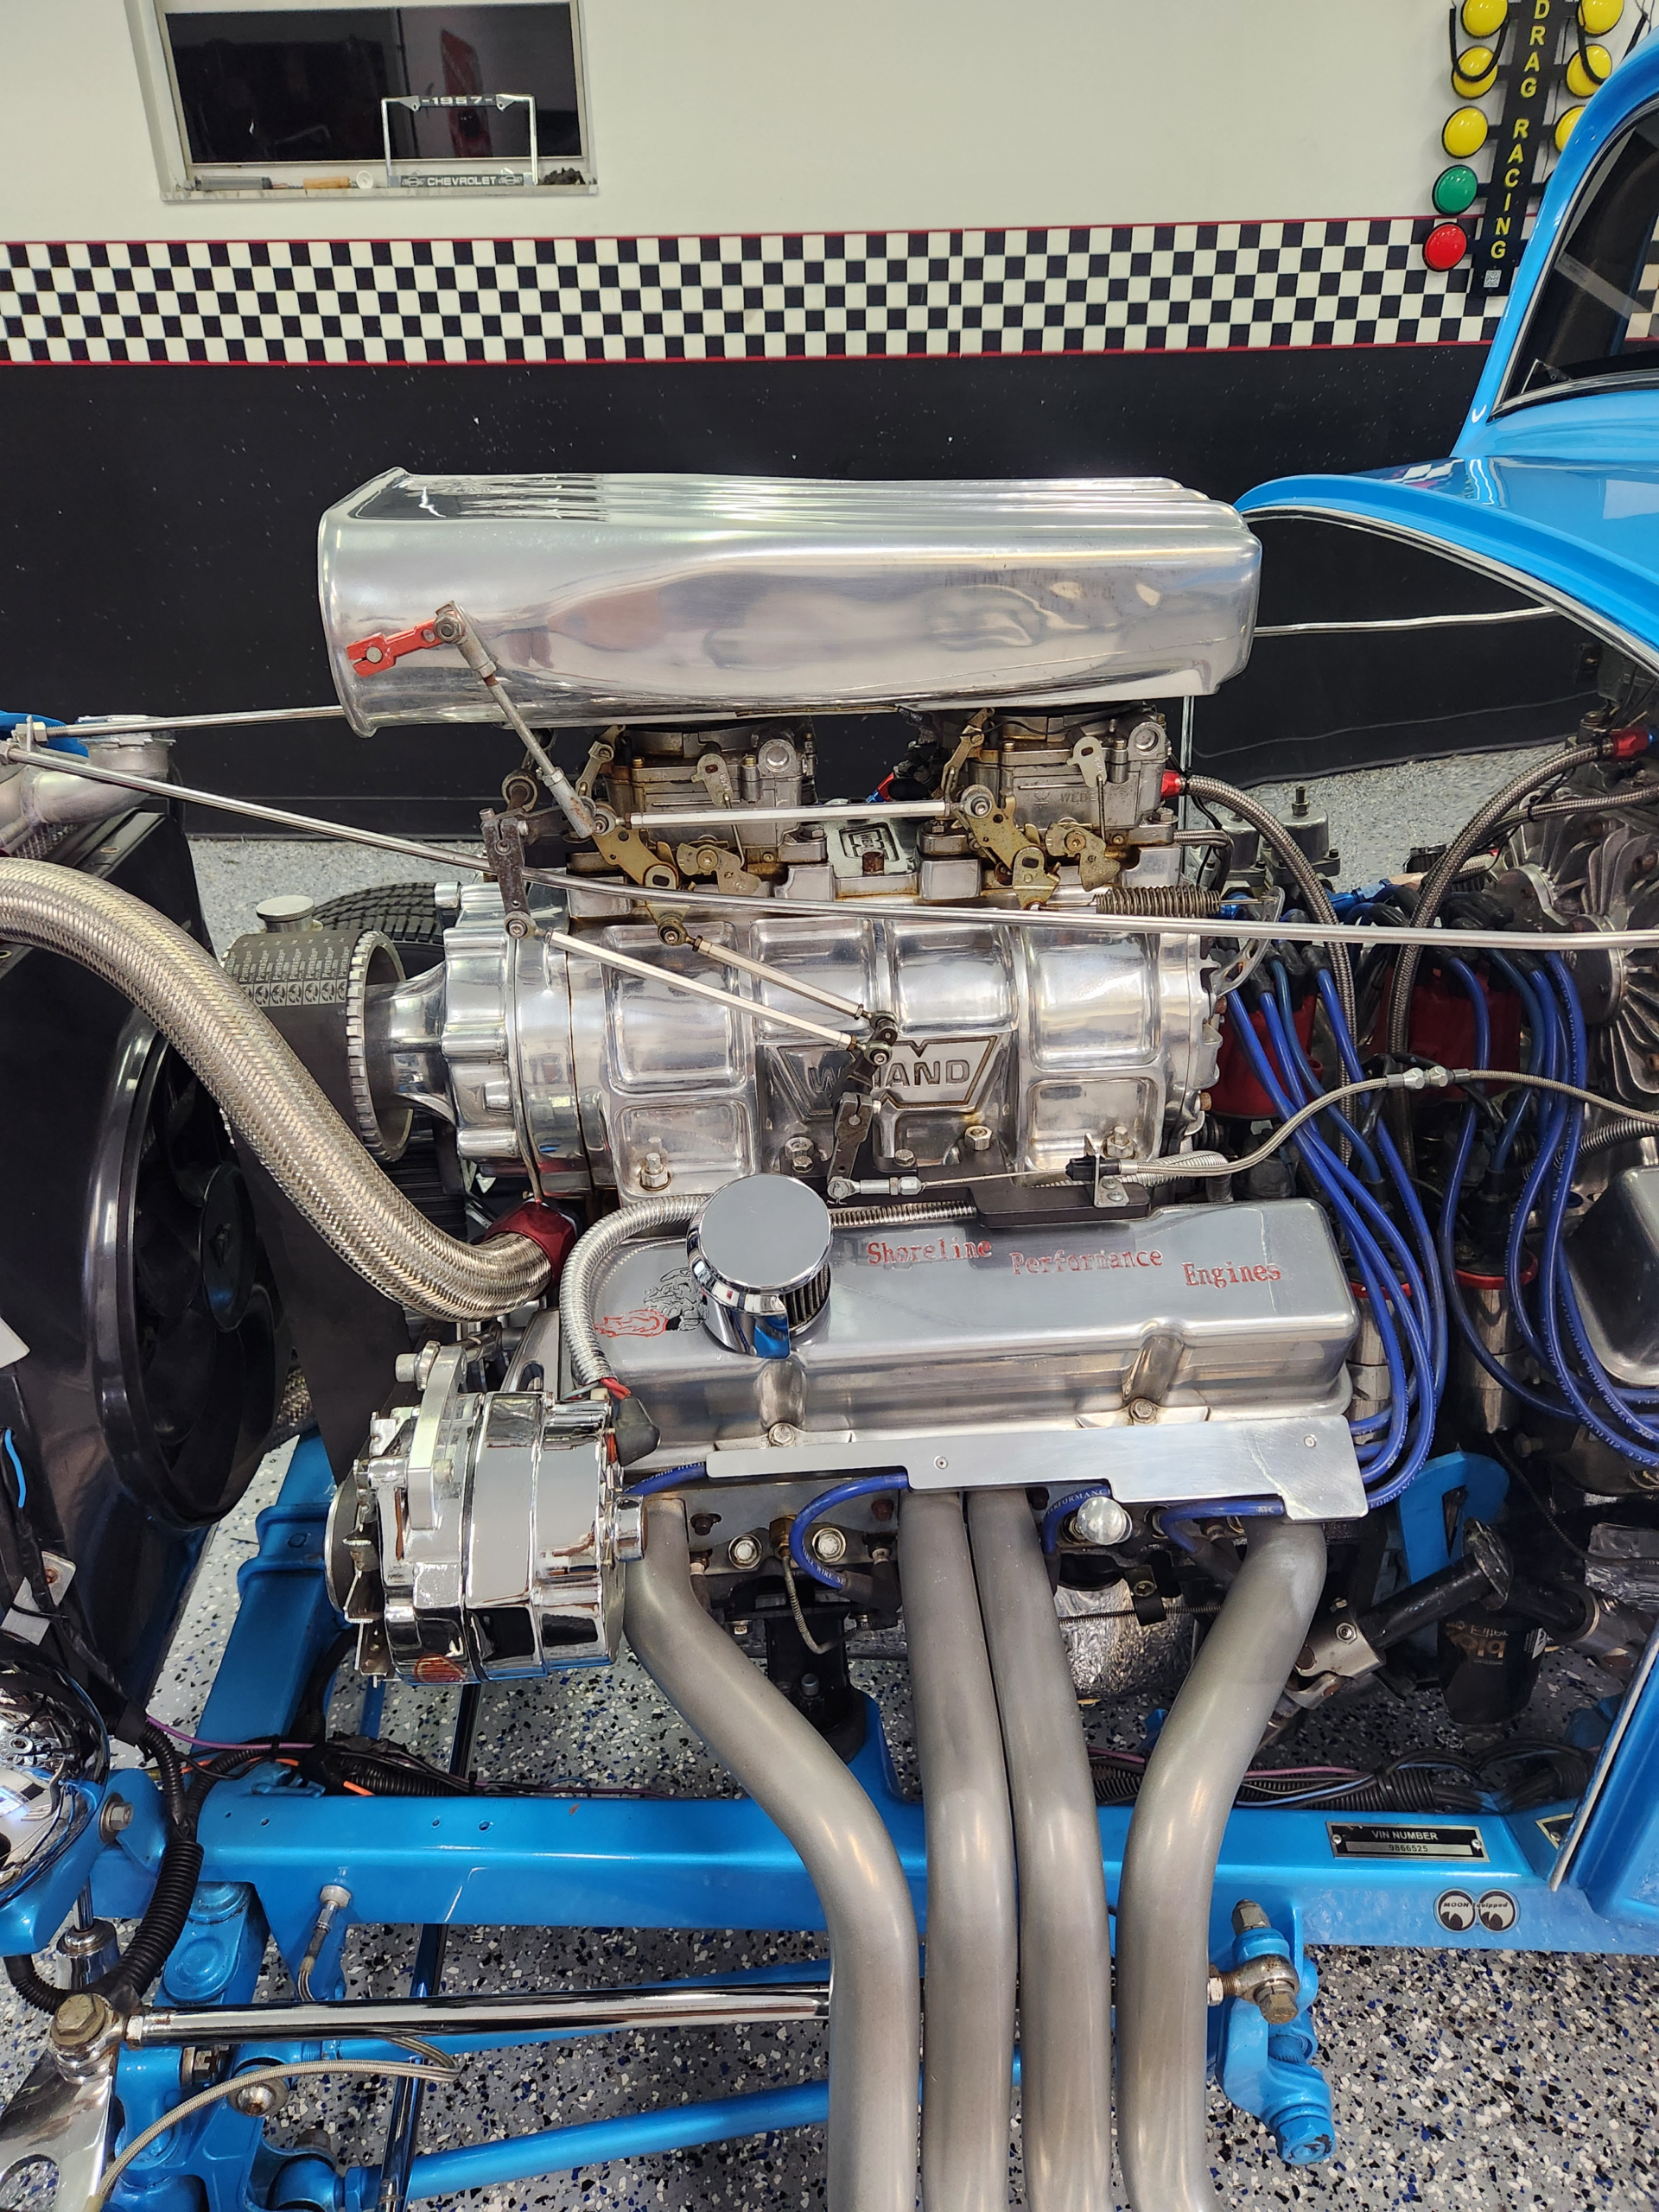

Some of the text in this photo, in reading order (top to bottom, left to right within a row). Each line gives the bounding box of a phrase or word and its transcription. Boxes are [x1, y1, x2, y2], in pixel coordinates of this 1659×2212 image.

[1491, 0, 1550, 259] DRAG RACING
[427, 175, 497, 187] CHEVROLET
[808, 1060, 970, 1092] WIAND
[867, 1236, 1282, 1289] Shoreline Performance Engines
[1369, 1474, 1415, 1510] FORMANCE
[817, 1565, 833, 1580] WIRE
[1372, 1830, 1439, 1841] VIN NUMBER
[1389, 1843, 1428, 1853] 9866525
